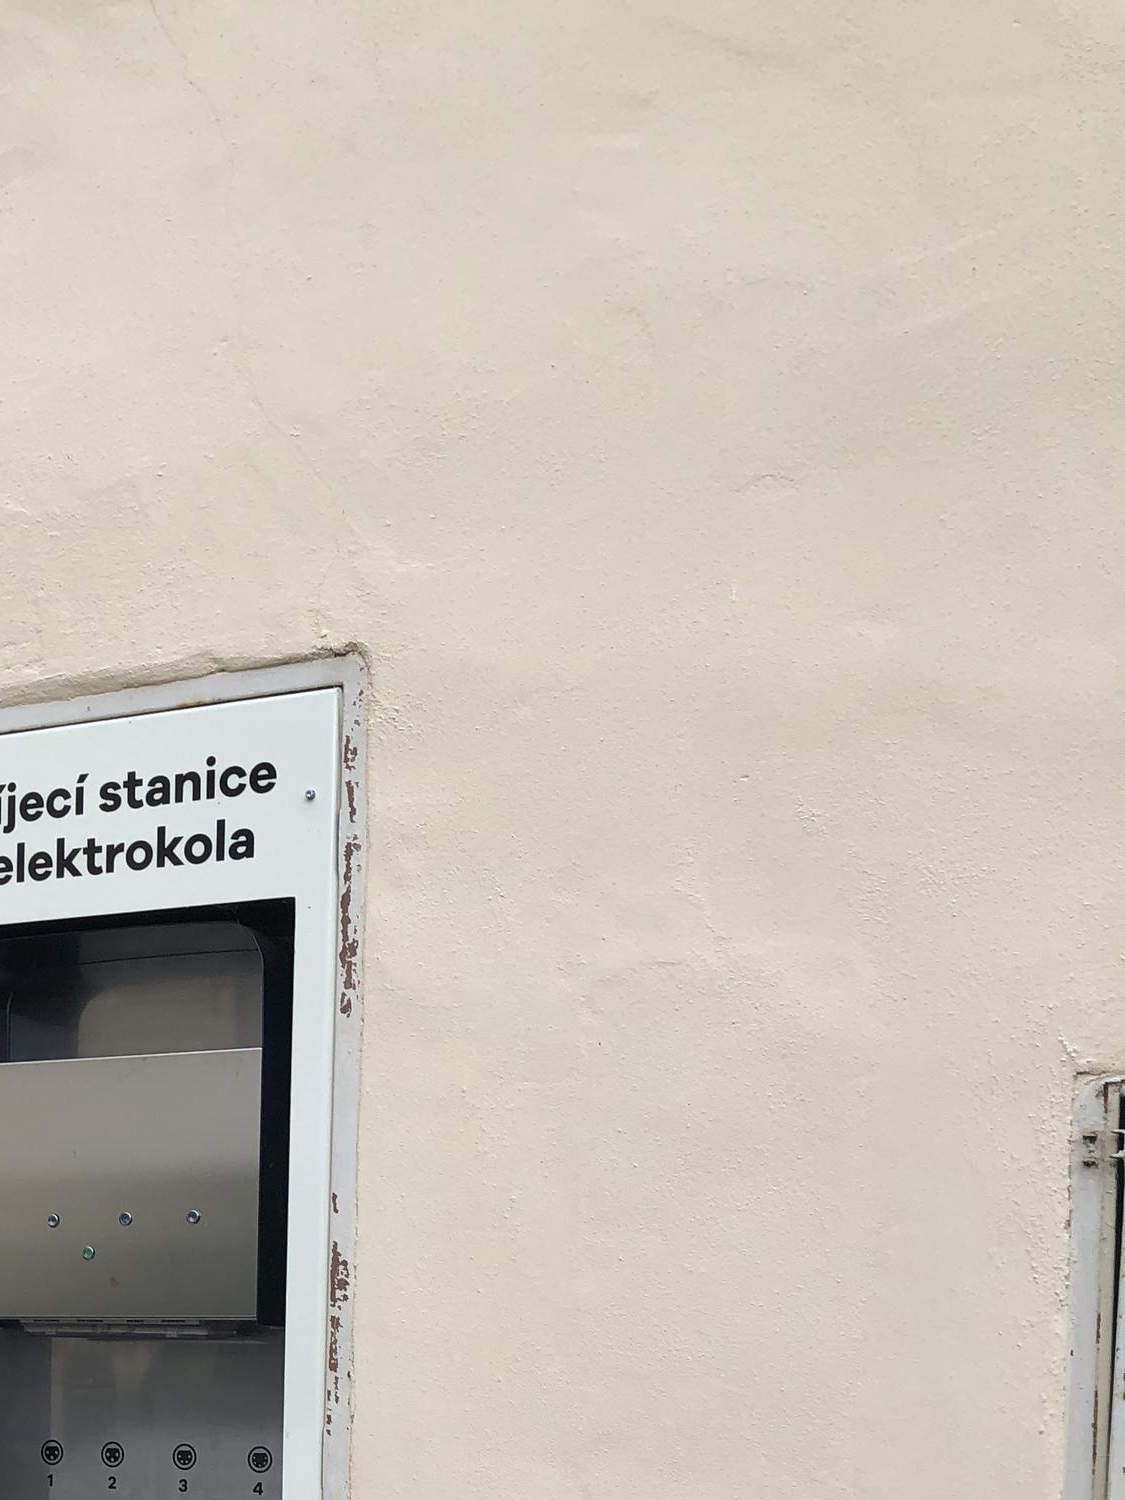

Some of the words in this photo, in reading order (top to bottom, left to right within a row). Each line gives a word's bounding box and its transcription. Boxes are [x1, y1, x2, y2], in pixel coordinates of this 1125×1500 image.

[98, 756, 277, 813] stanice
[47, 1474, 55, 1487] 1
[108, 1476, 117, 1490] 2
[178, 1478, 188, 1493] 3
[252, 1481, 264, 1496] 4
